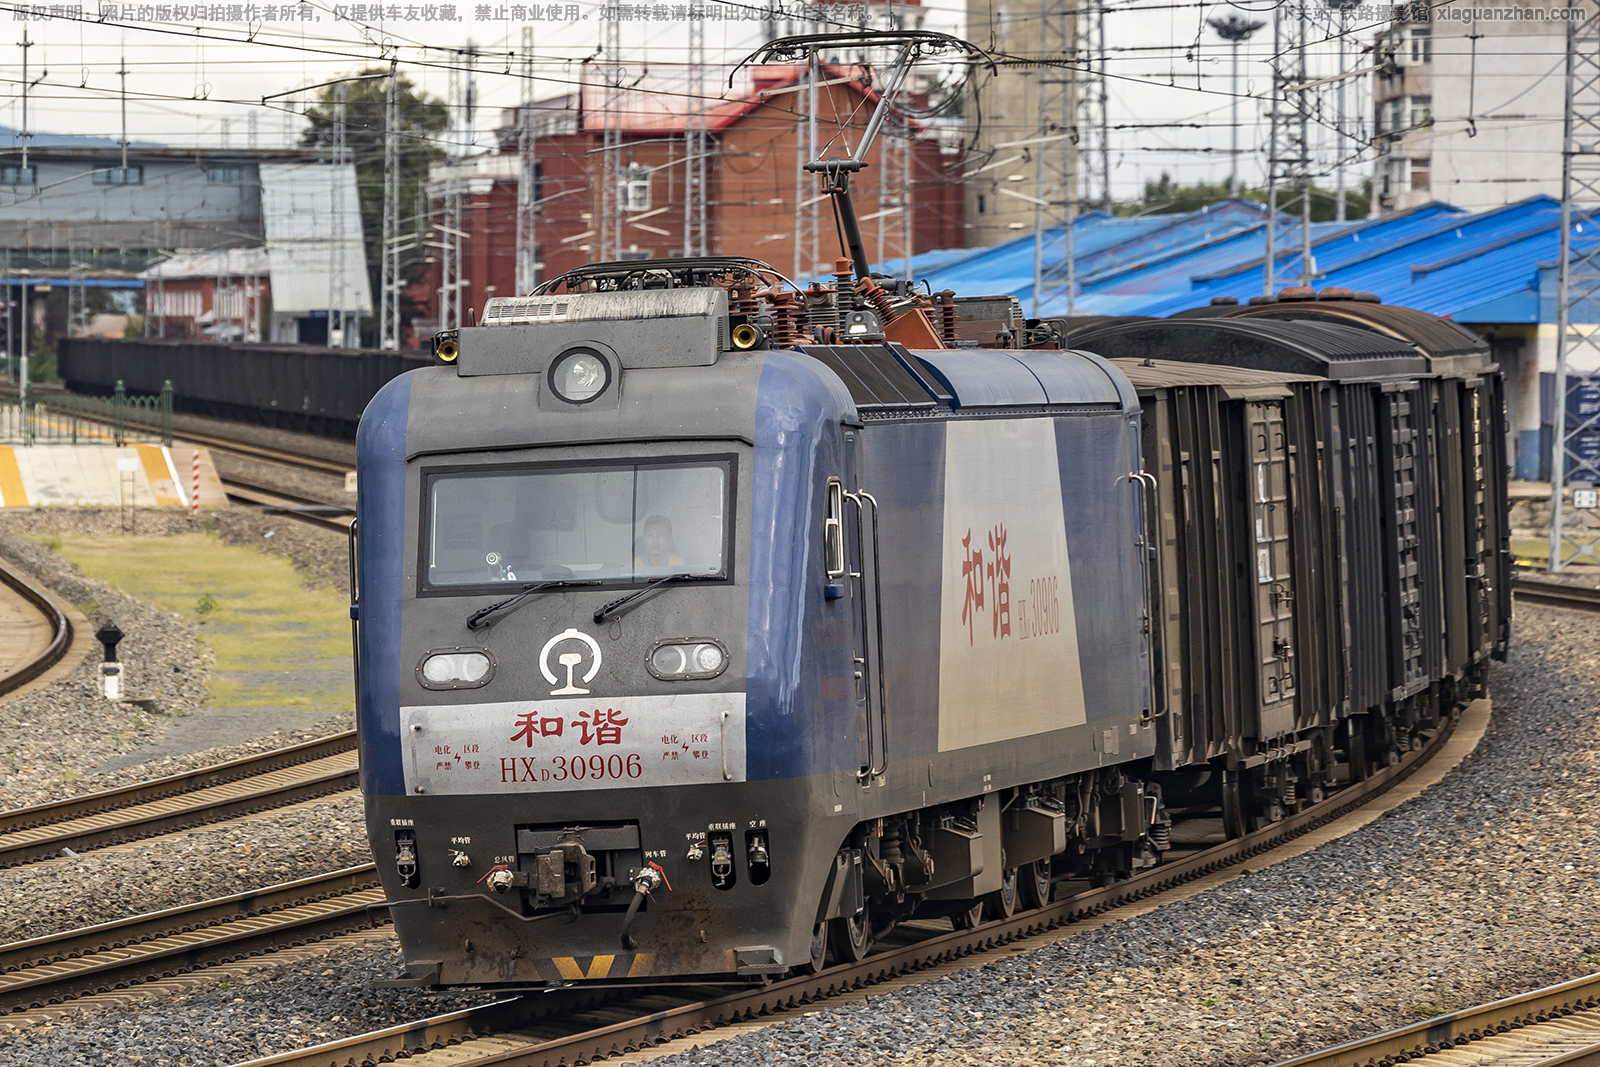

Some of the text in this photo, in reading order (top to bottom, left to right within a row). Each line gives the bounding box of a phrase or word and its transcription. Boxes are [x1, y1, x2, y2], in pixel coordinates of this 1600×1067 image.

[961, 522, 1011, 647] 和谐
[510, 708, 630, 748] 和谐
[661, 733, 708, 745] 电化 区段
[434, 743, 480, 755] 电化 区段
[662, 751, 680, 761] 严禁
[436, 761, 452, 771] 严禁
